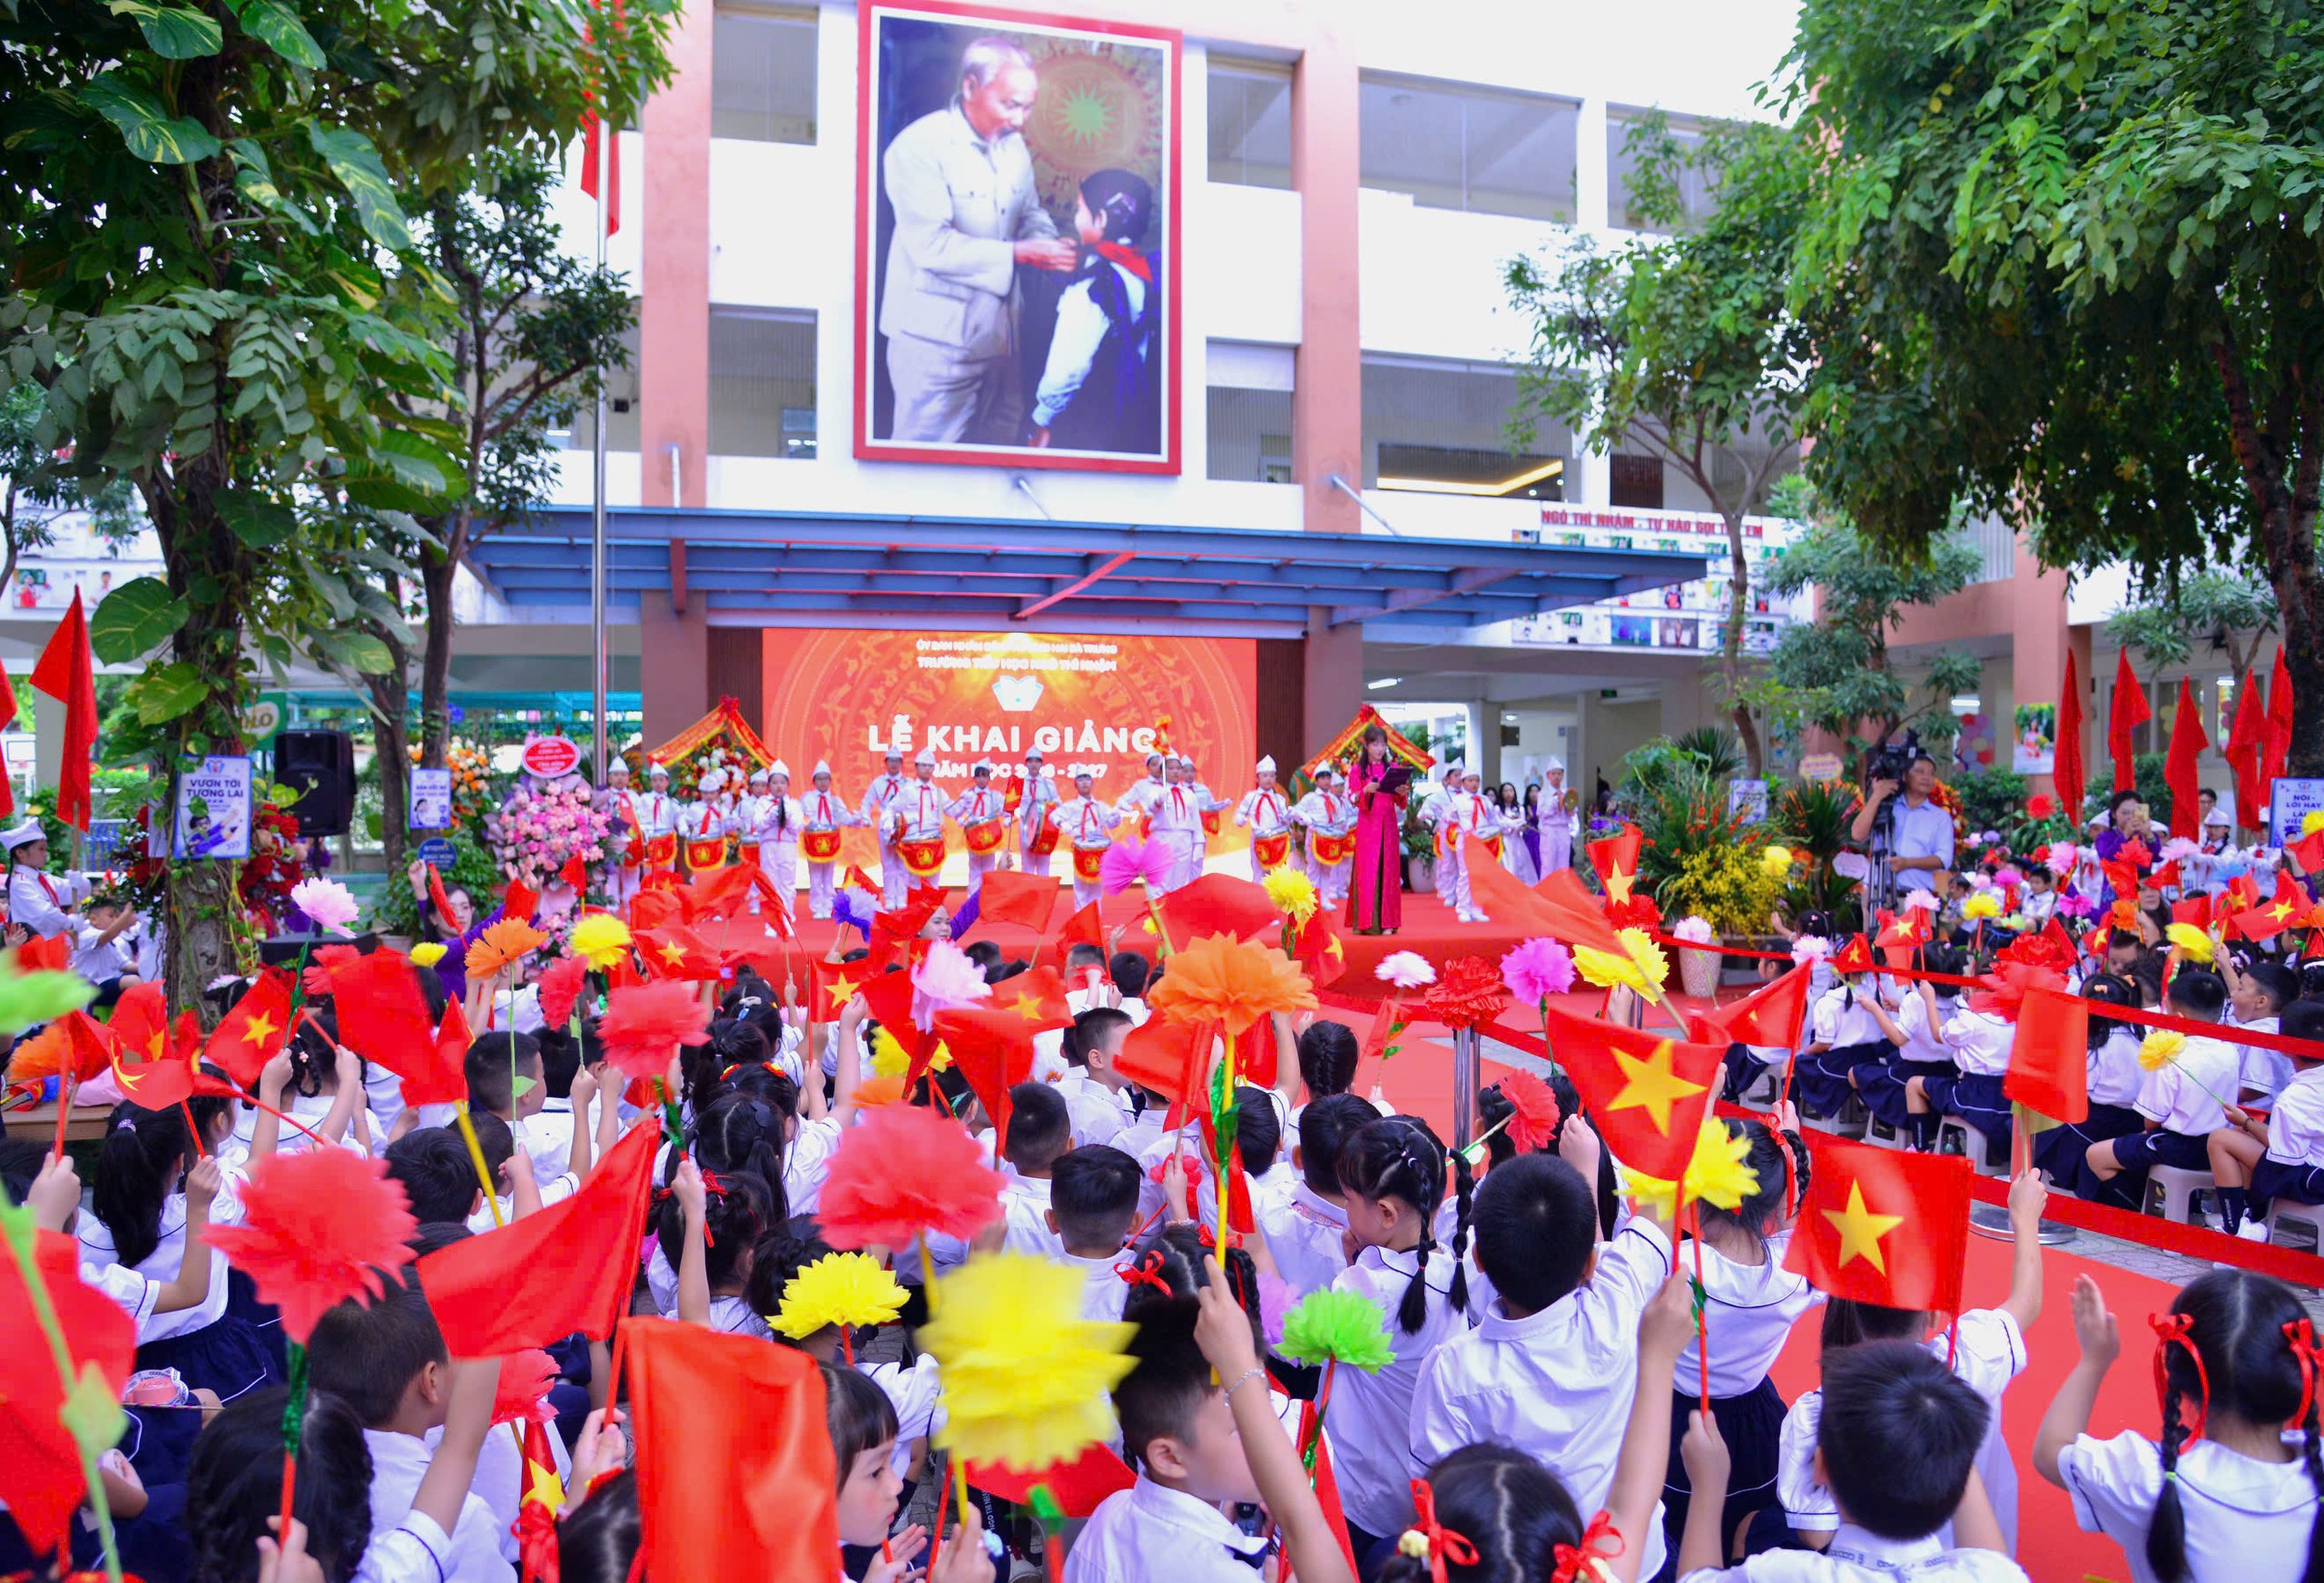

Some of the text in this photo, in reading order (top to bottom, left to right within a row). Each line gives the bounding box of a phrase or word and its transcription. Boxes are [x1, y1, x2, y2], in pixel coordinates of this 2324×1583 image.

[869, 713, 1157, 754] LỄ KHAI GIẢNG
[190, 779, 221, 788] VƯƠN
[186, 788, 243, 798] TƯƠNG LAI
